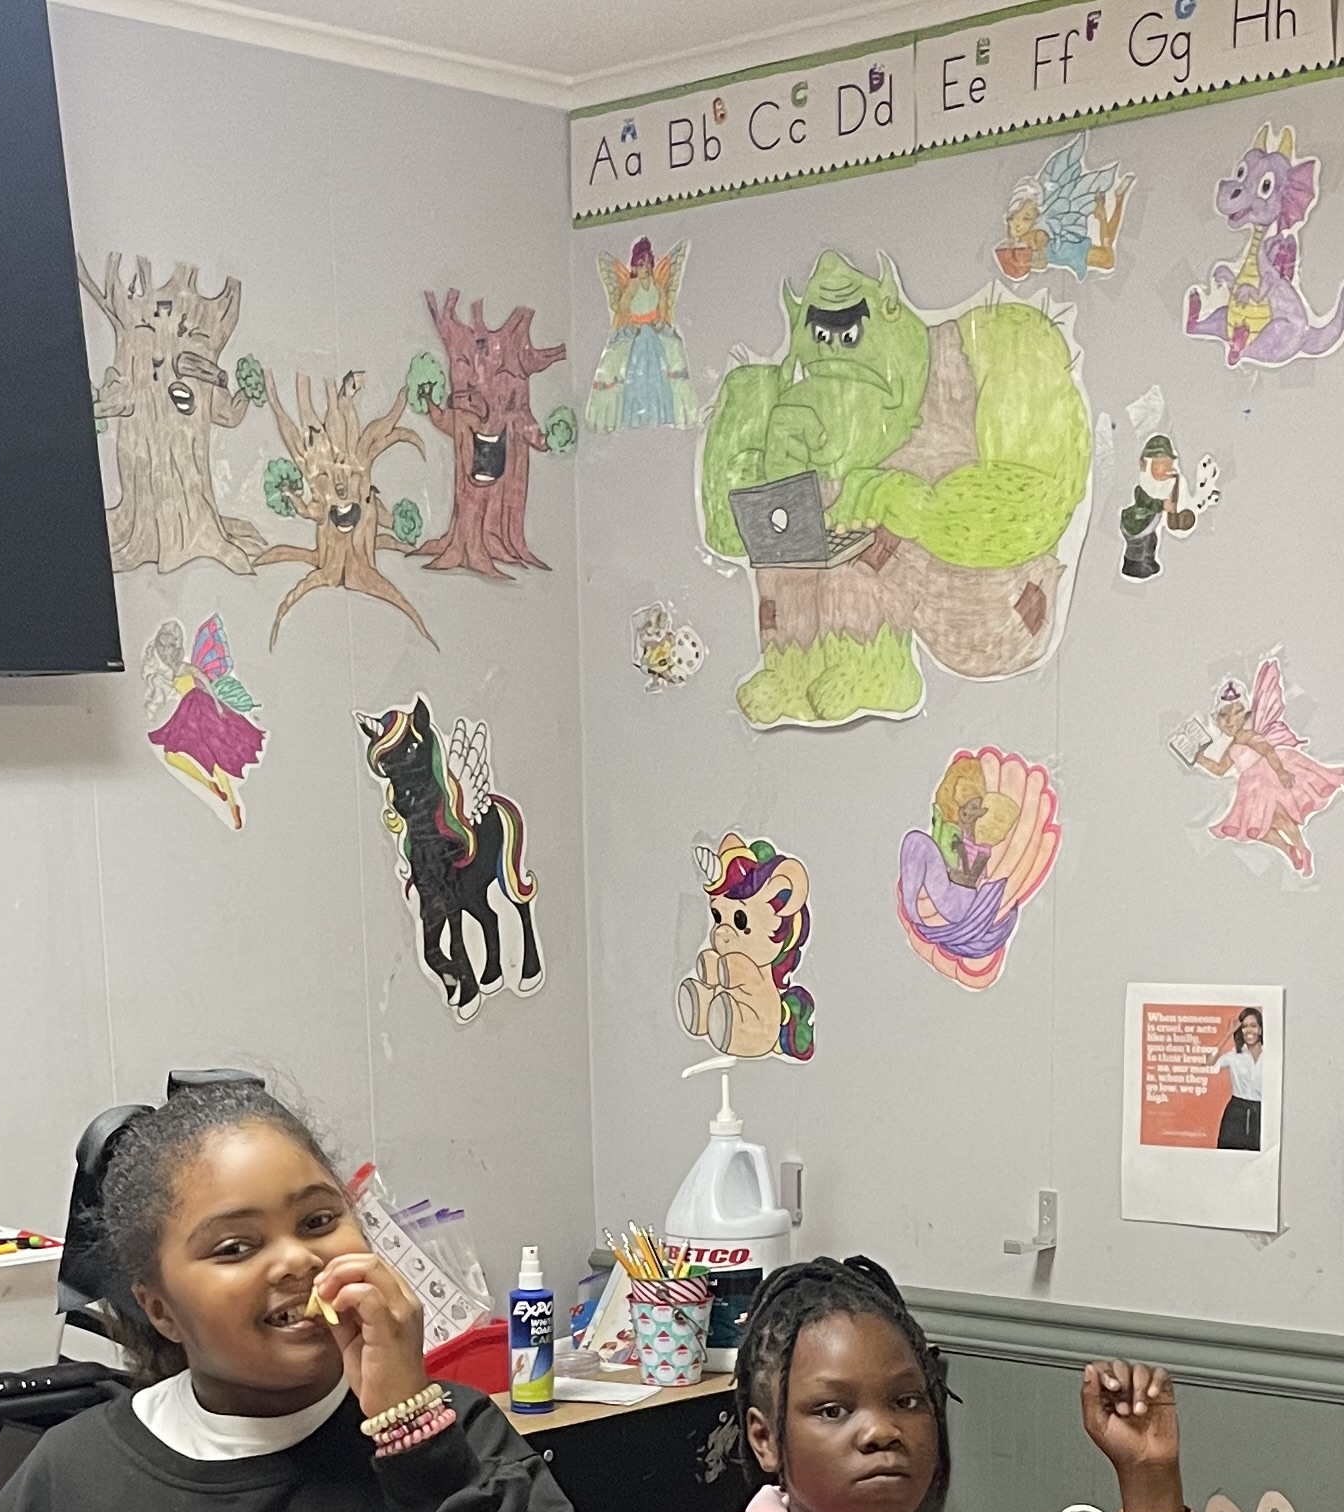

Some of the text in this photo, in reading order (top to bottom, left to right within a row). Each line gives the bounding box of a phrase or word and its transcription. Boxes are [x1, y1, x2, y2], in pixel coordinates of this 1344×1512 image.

[589, 137, 642, 185] Aa
[669, 113, 722, 169] Bb
[749, 102, 806, 151] Cc
[838, 74, 894, 136] Dd
[943, 55, 987, 111] Ee
[1034, 29, 1079, 90] Ff
[1128, 12, 1191, 82] Gg
[513, 1300, 553, 1323] EXPO
